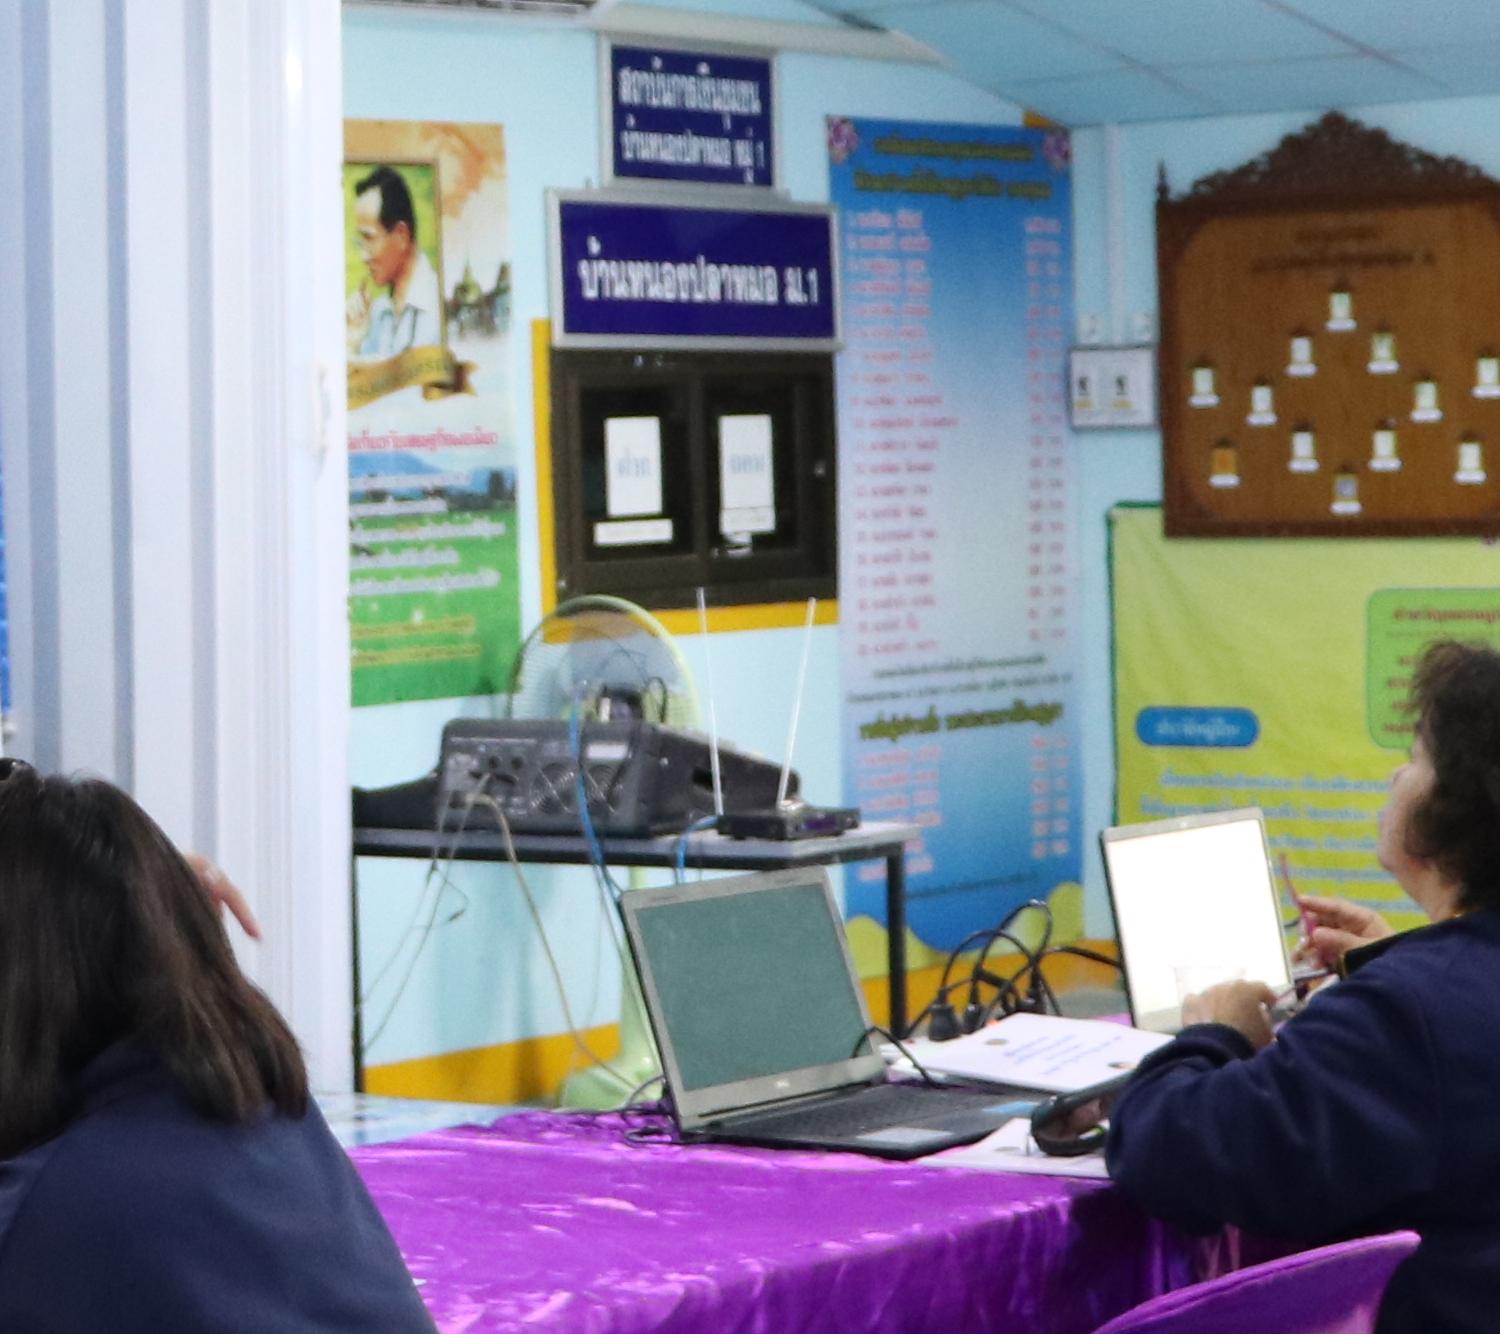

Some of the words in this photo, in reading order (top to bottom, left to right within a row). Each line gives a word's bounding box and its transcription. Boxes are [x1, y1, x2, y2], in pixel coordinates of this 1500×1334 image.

[618, 55, 763, 130] สถาบันการเงินชุมชน
[620, 113, 732, 168] บ้านหนองปลาหมอ
[756, 140, 765, 168] 1
[577, 234, 778, 305] บ้านหนองปลาหมอ
[784, 266, 818, 306] ม.1
